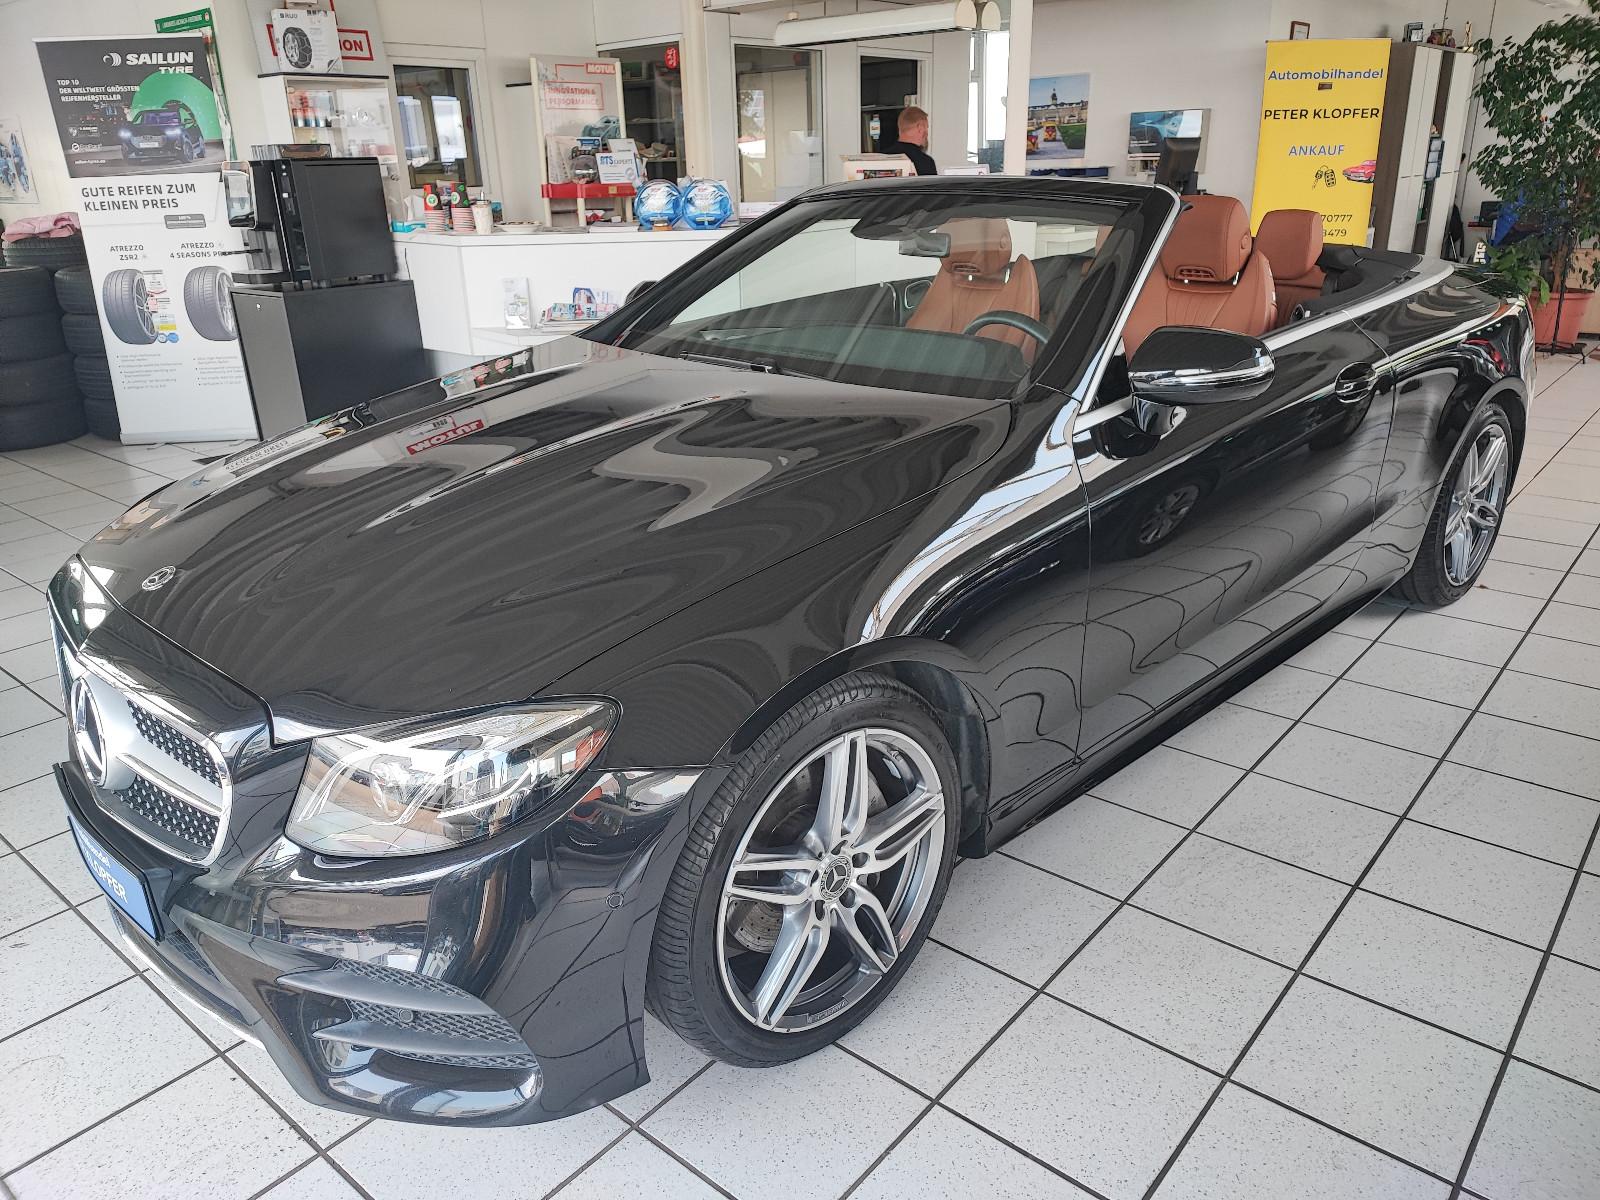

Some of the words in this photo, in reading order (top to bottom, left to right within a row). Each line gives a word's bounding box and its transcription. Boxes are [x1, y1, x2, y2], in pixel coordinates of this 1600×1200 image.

[126, 52, 194, 66] SAILUN
[159, 65, 194, 75] TYRE
[587, 64, 615, 74] MOTUL
[1268, 68, 1384, 80] Automobilhandel
[73, 86, 105, 94] WELTWEIT
[106, 84, 140, 92] GRÖSSTEN
[548, 87, 590, 96] INNOVATION
[61, 94, 121, 102] REIFENHERSTELLER
[549, 97, 600, 107] PERFORMANCE
[1264, 109, 1309, 120] PETER
[1313, 108, 1380, 119] KLOPFER
[1288, 145, 1345, 156] ANKAUF
[81, 186, 115, 198] GUTE
[118, 184, 163, 196] REIFEN
[166, 183, 196, 194] ZUM
[84, 199, 139, 212] KLEINEN
[142, 198, 179, 209] PREIS
[1320, 214, 1353, 223] 70777
[176, 251, 211, 259] SEASONS
